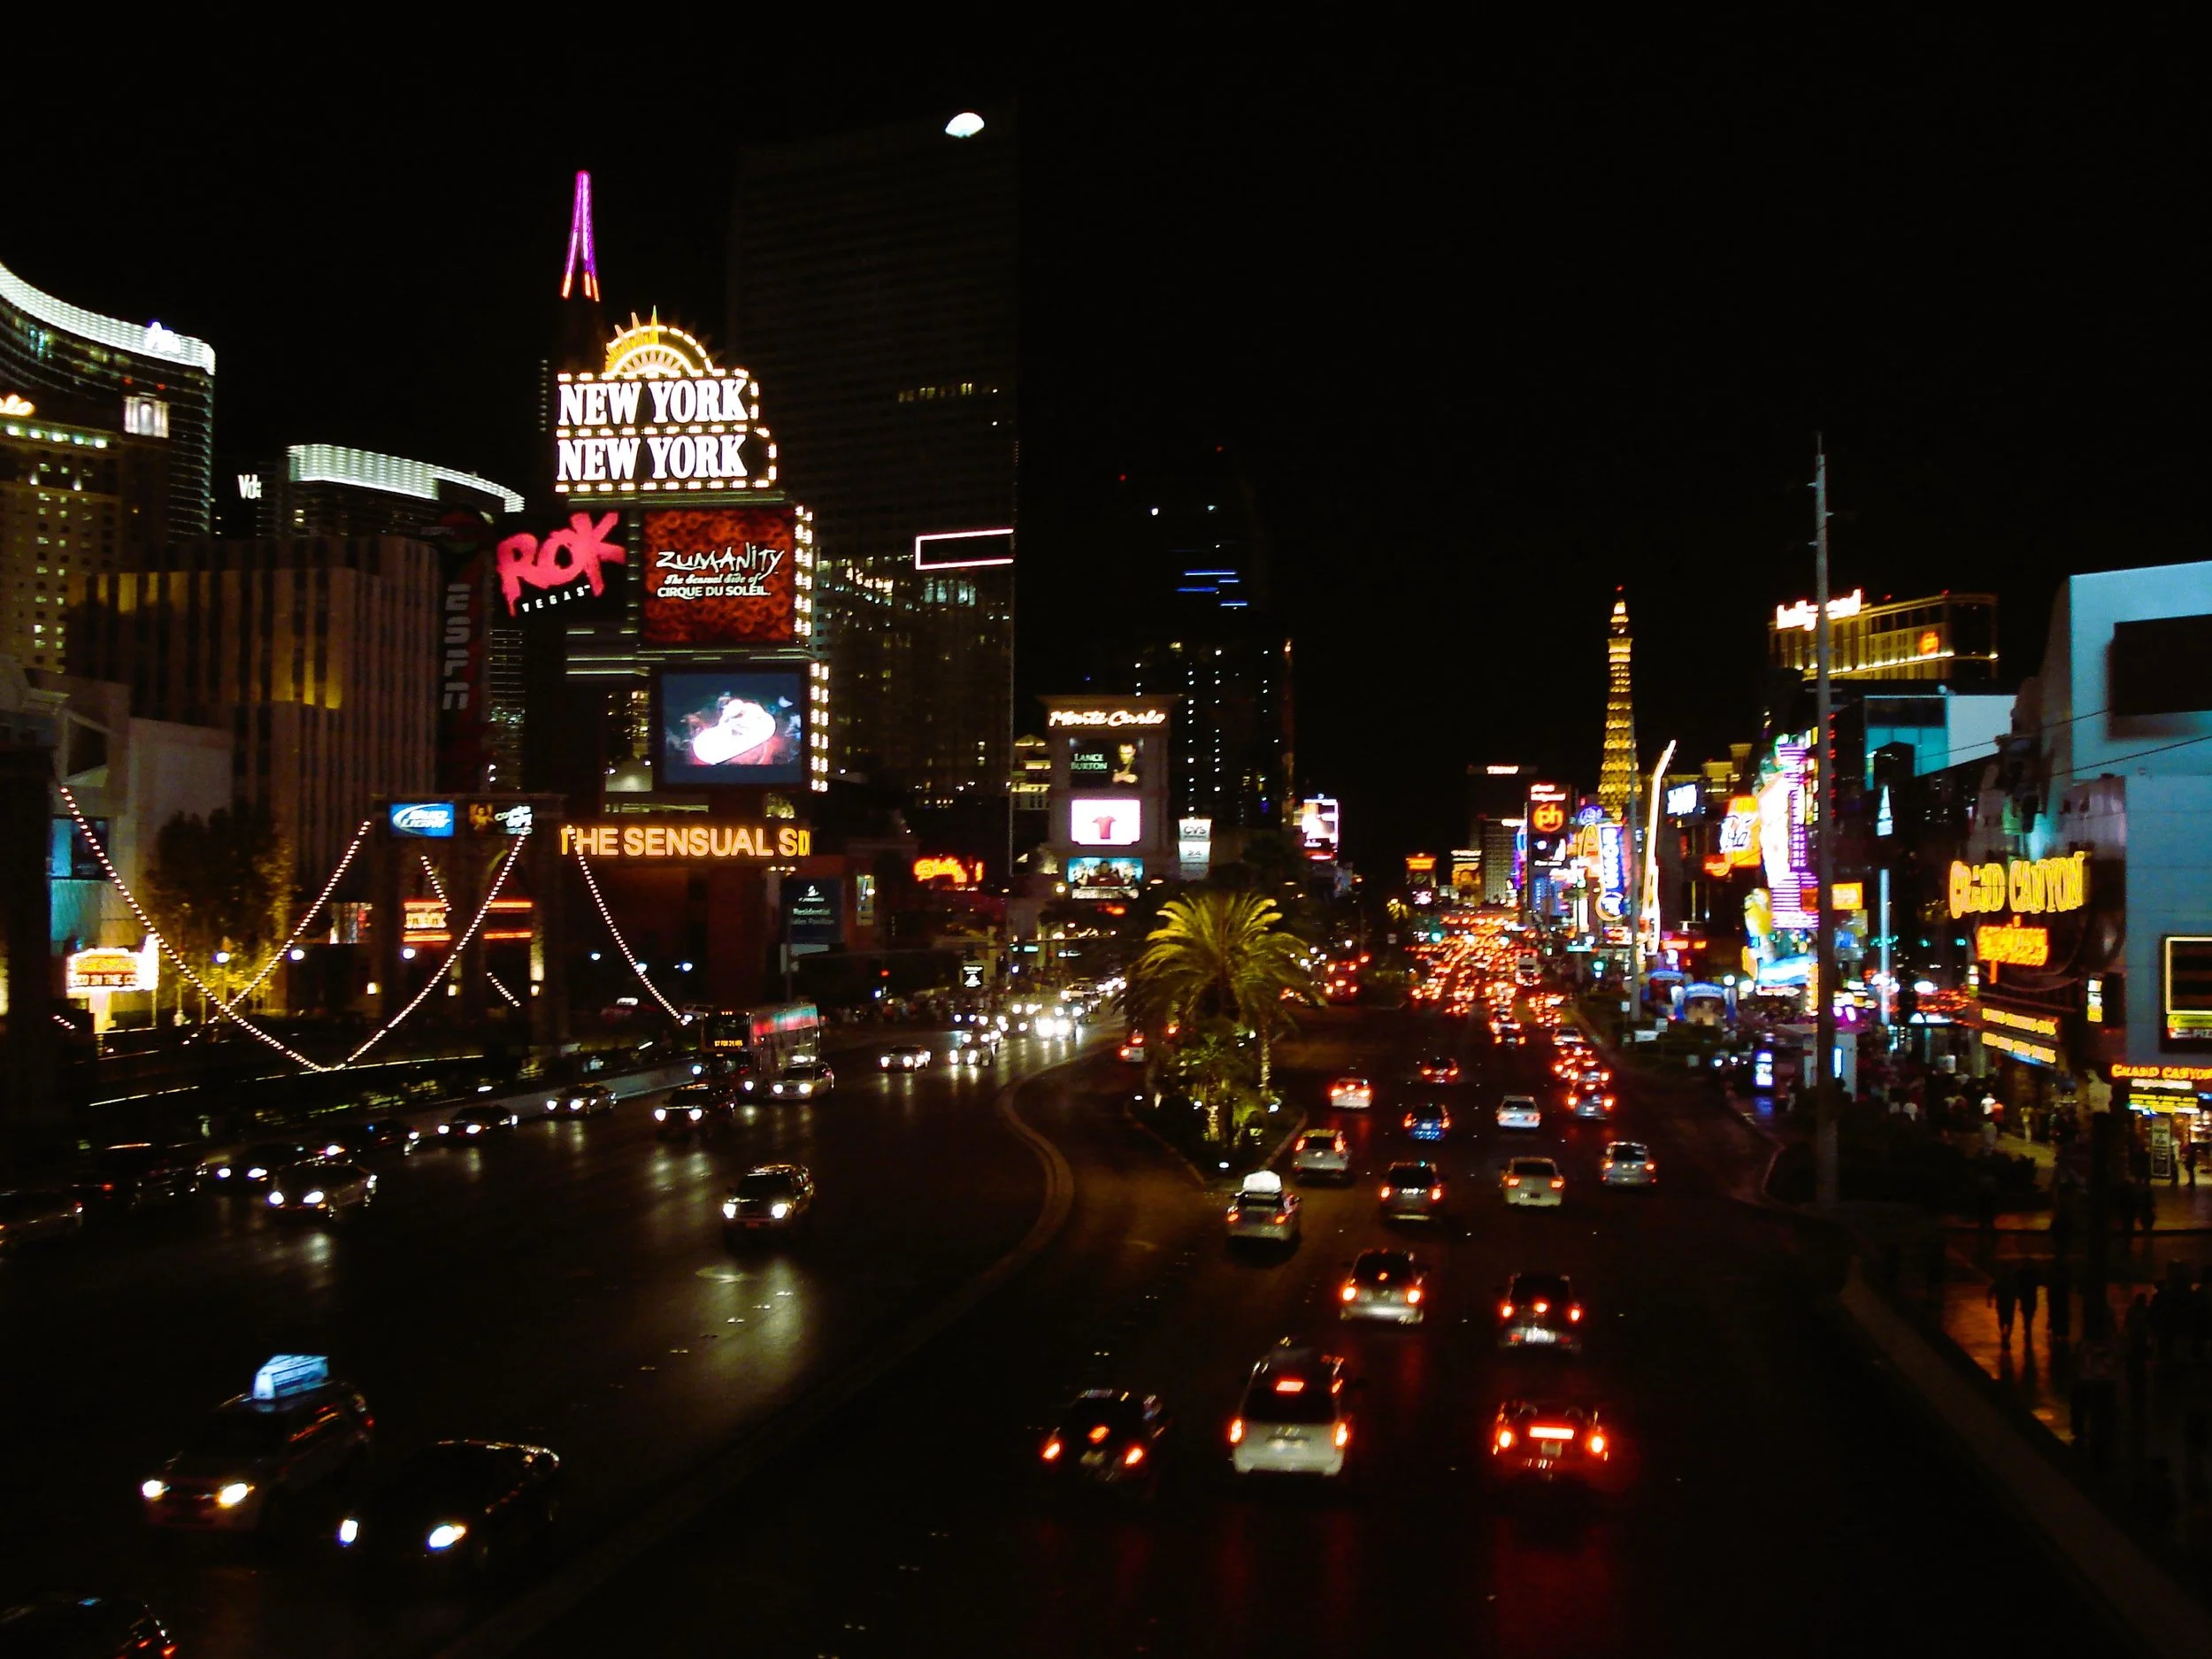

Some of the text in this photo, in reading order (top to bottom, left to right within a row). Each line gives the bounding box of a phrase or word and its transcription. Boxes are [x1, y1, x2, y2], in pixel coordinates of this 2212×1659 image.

[558, 378, 749, 426] NEW YORK
[557, 434, 749, 482] NEW YORK
[496, 511, 626, 617] ROK
[664, 572, 763, 586] The Sensual Side of
[657, 585, 768, 599] CIRQUE DU SOLEIL
[1048, 709, 1166, 727] Monte Carlo
[1073, 753, 1104, 762] LANCE
[1070, 761, 1108, 771] BURTON
[1184, 826, 1206, 835] CVS
[560, 827, 619, 856] THE
[623, 827, 774, 856] SENSUAL
[1949, 851, 2085, 919] GRAND CANYON
[2111, 1064, 2160, 1078] GRAND
